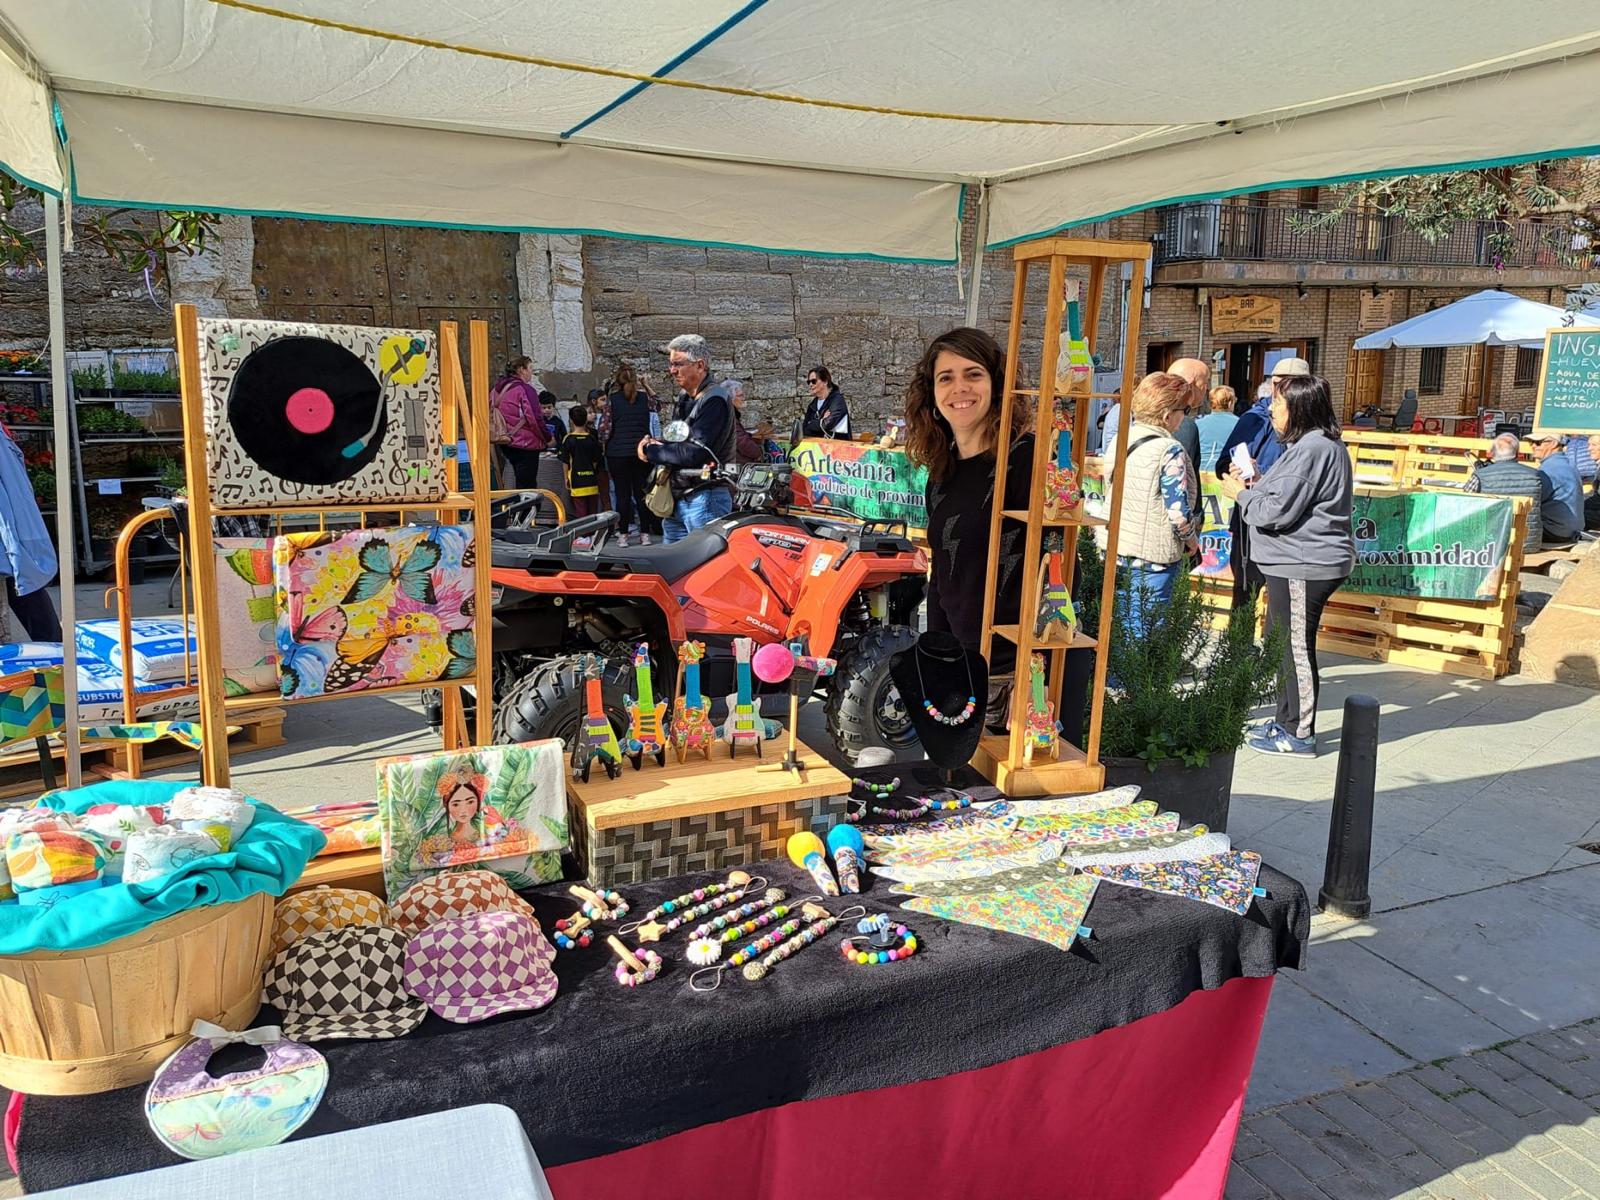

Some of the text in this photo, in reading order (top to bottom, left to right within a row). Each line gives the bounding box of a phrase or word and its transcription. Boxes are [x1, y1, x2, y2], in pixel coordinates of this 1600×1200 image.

[1241, 299, 1254, 308] BAR
[1557, 334, 1600, 357] ING
[797, 449, 897, 484] Artesanía
[810, 477, 926, 507] roducto de proxim
[1354, 540, 1497, 568] roximidad
[1377, 573, 1396, 588] de
[745, 615, 780, 635] POLARIS
